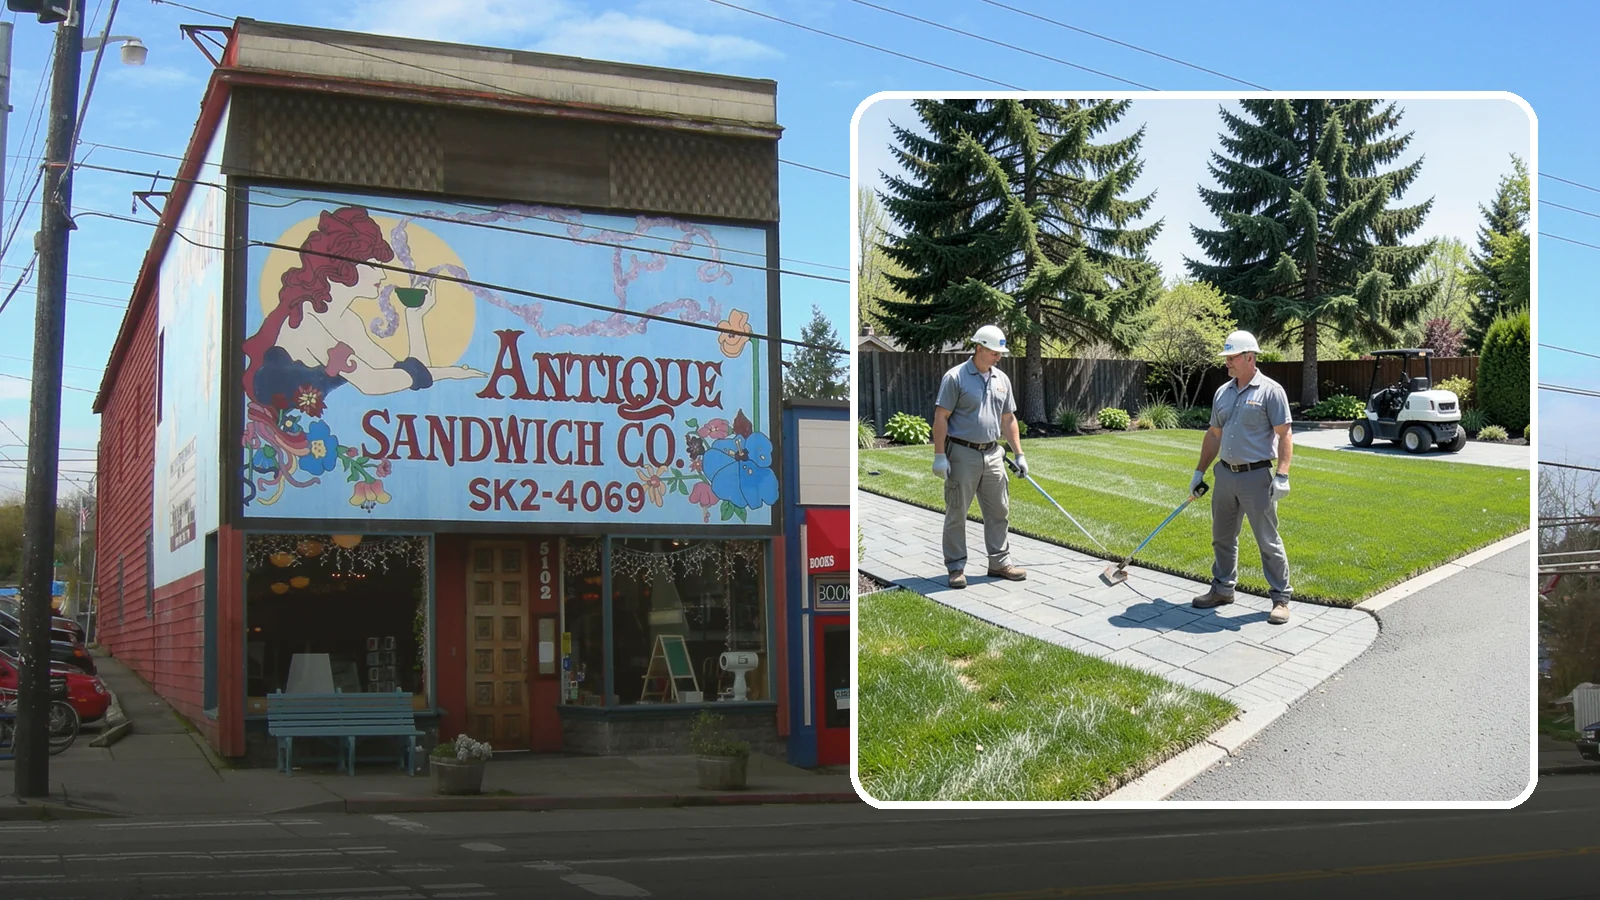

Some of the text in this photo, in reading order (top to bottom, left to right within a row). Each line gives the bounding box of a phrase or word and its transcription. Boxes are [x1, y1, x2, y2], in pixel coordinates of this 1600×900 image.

[475, 329, 723, 421] ANTIQUE
[361, 408, 685, 469] SANDWICH CO.
[468, 477, 646, 513] SK2-4069
[540, 541, 551, 599] 5102
[809, 555, 835, 569] BOOKS
